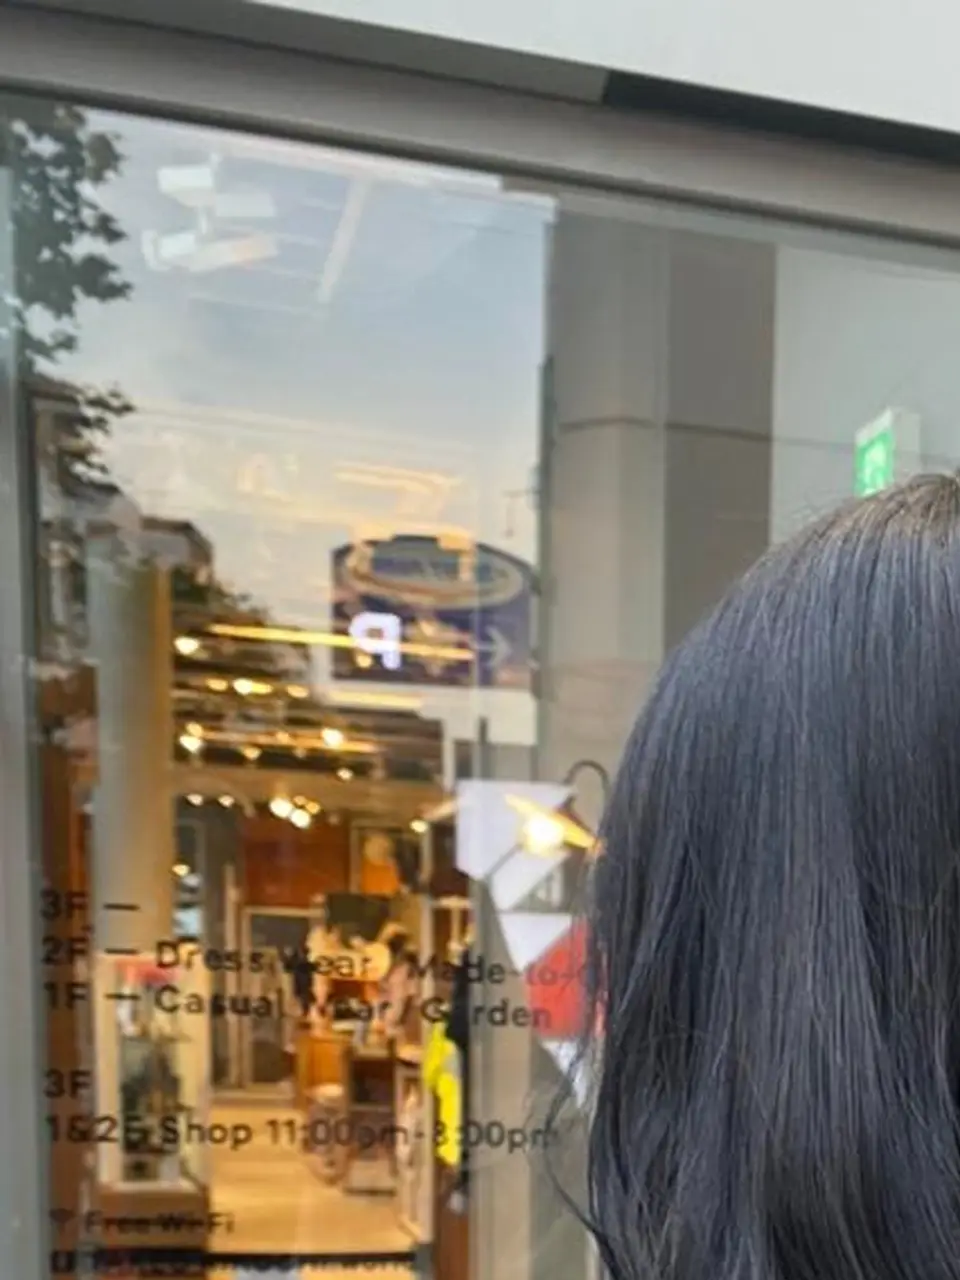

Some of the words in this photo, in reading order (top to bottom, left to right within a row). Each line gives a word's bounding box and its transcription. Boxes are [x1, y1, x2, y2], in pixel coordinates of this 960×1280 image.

[42, 890, 90, 919] 3F
[42, 935, 90, 966] 2F
[156, 940, 264, 971] Dress
[43, 982, 89, 1009] 1F
[154, 985, 283, 1018] Casual
[43, 1070, 92, 1098] 3F
[160, 1115, 253, 1149] Shop
